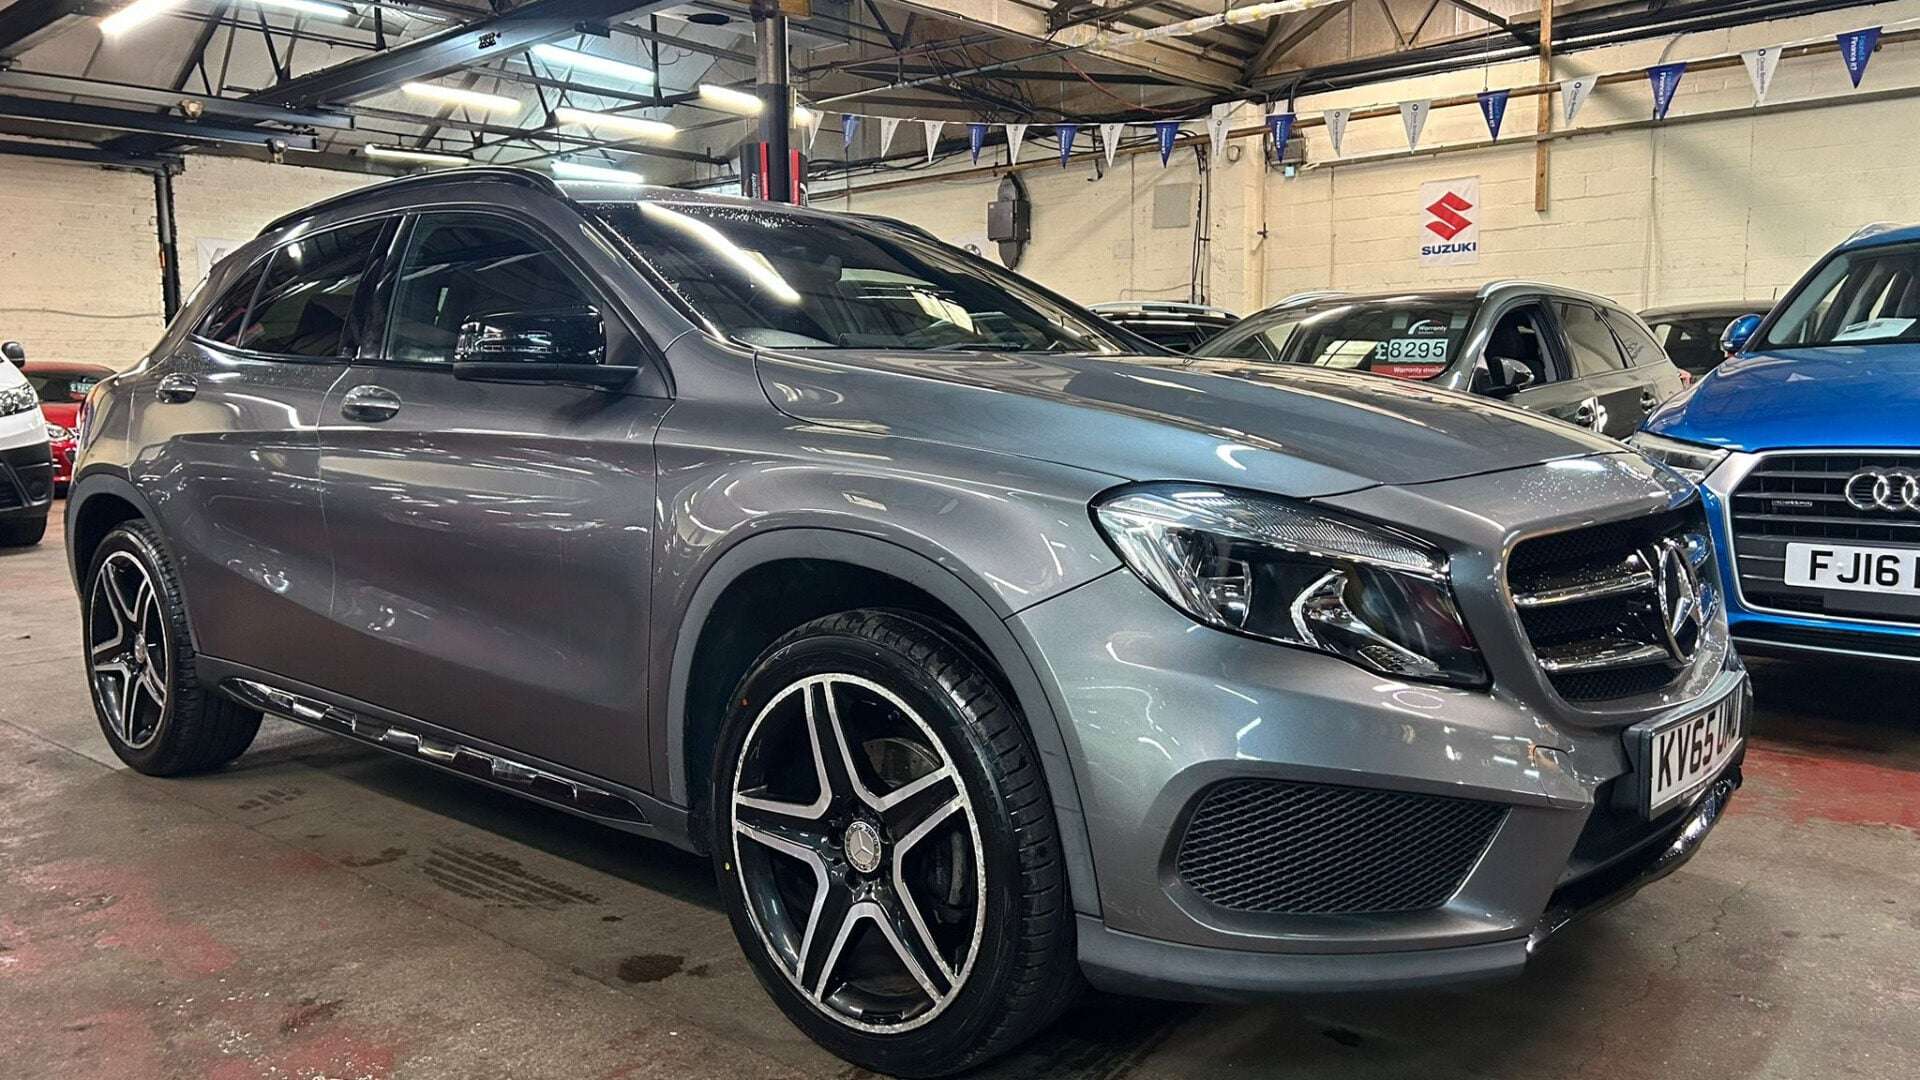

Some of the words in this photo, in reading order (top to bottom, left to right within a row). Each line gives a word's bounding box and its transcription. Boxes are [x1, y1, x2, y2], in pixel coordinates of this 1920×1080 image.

[1421, 241, 1477, 256] SUZUKI
[1375, 340, 1446, 360] £8295
[1393, 366, 1421, 374] Warranty
[1808, 549, 1901, 587] FJ16
[1657, 709, 1717, 793] KV65
